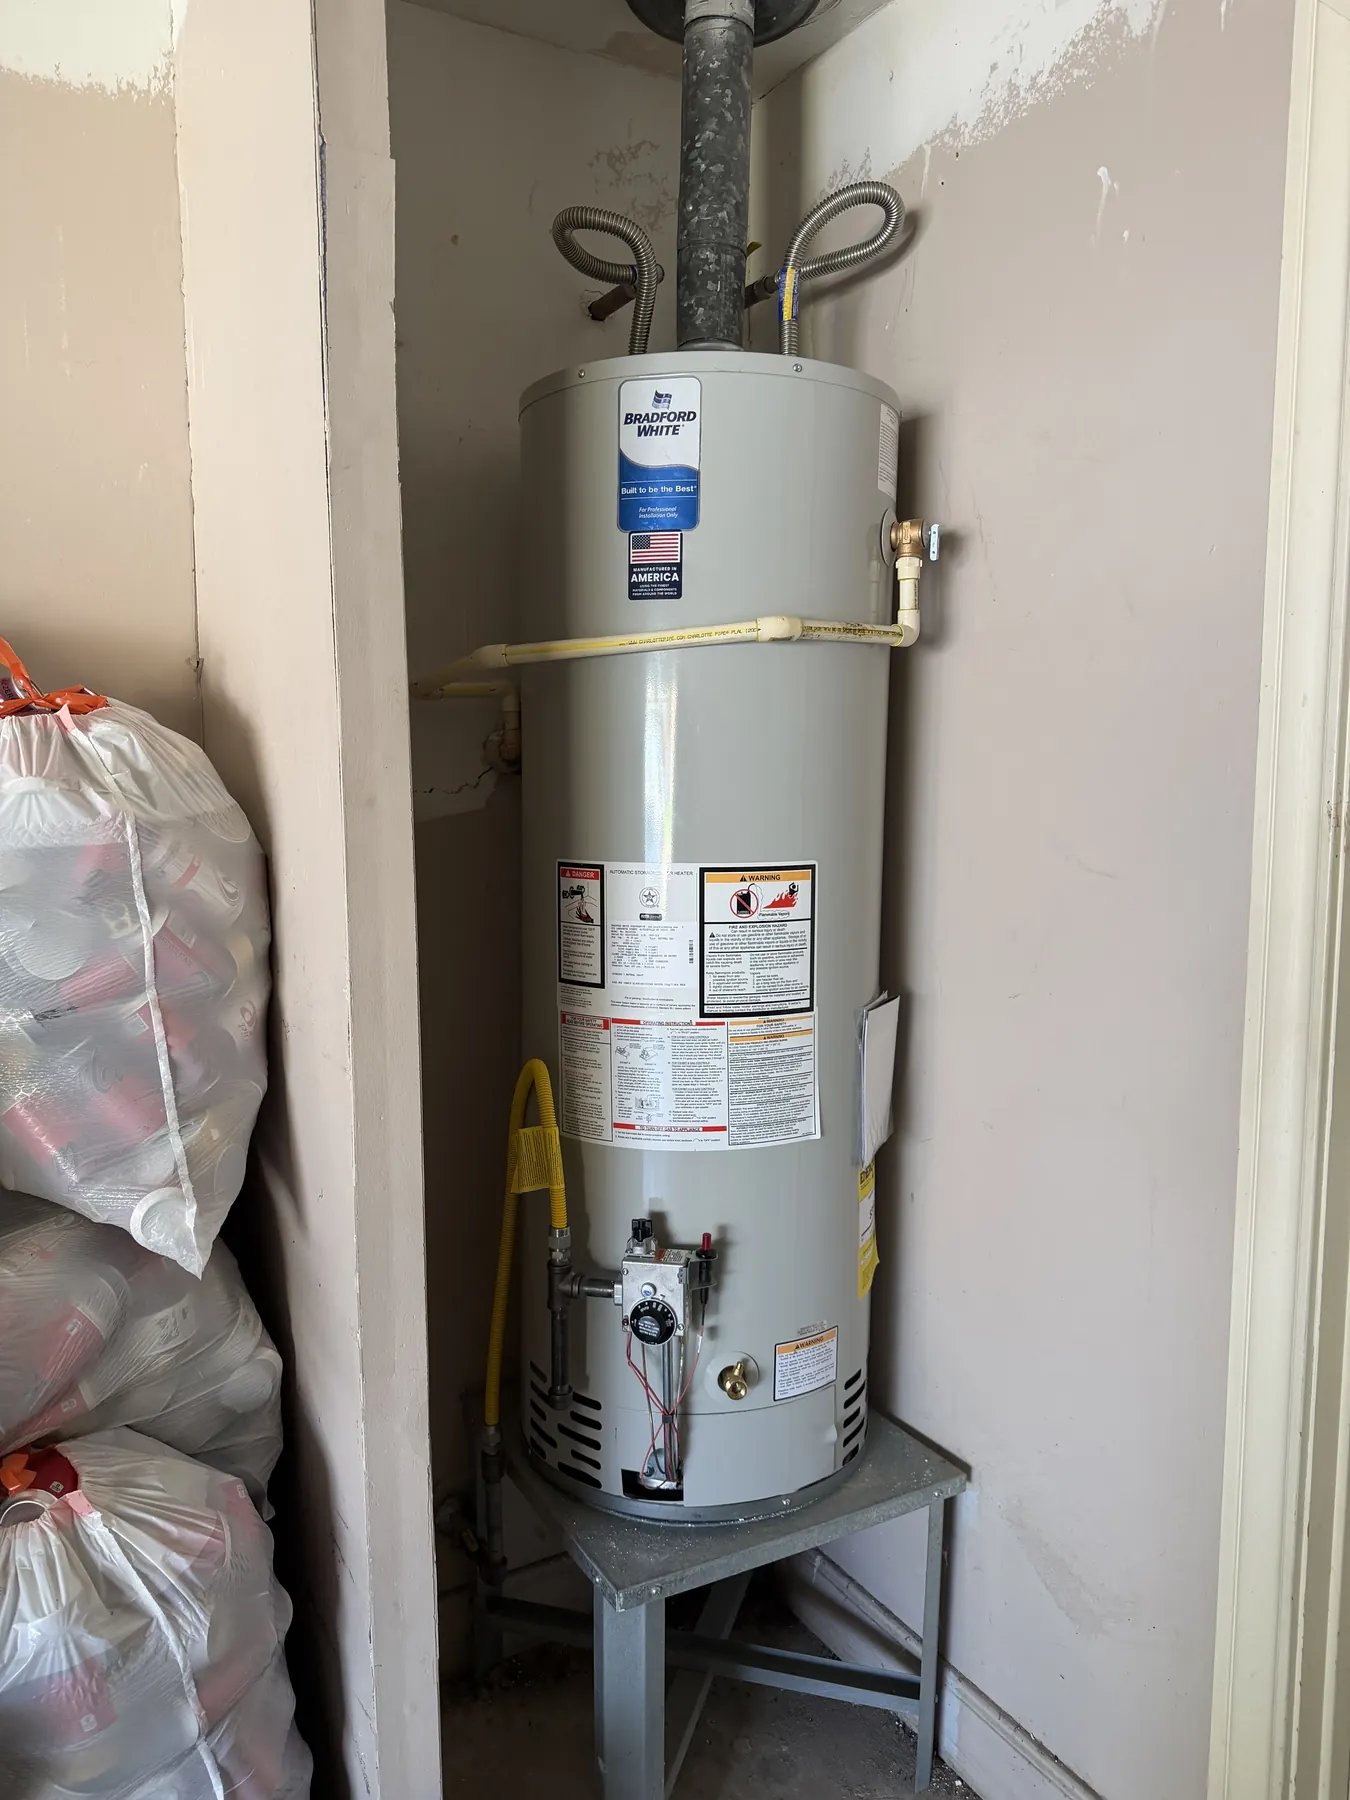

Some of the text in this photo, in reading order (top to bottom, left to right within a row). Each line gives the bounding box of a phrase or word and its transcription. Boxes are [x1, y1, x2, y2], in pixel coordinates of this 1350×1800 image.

[624, 411, 697, 425] BRADFORD
[630, 572, 680, 582] AMERICA
[800, 1336, 824, 1348] WARNING
